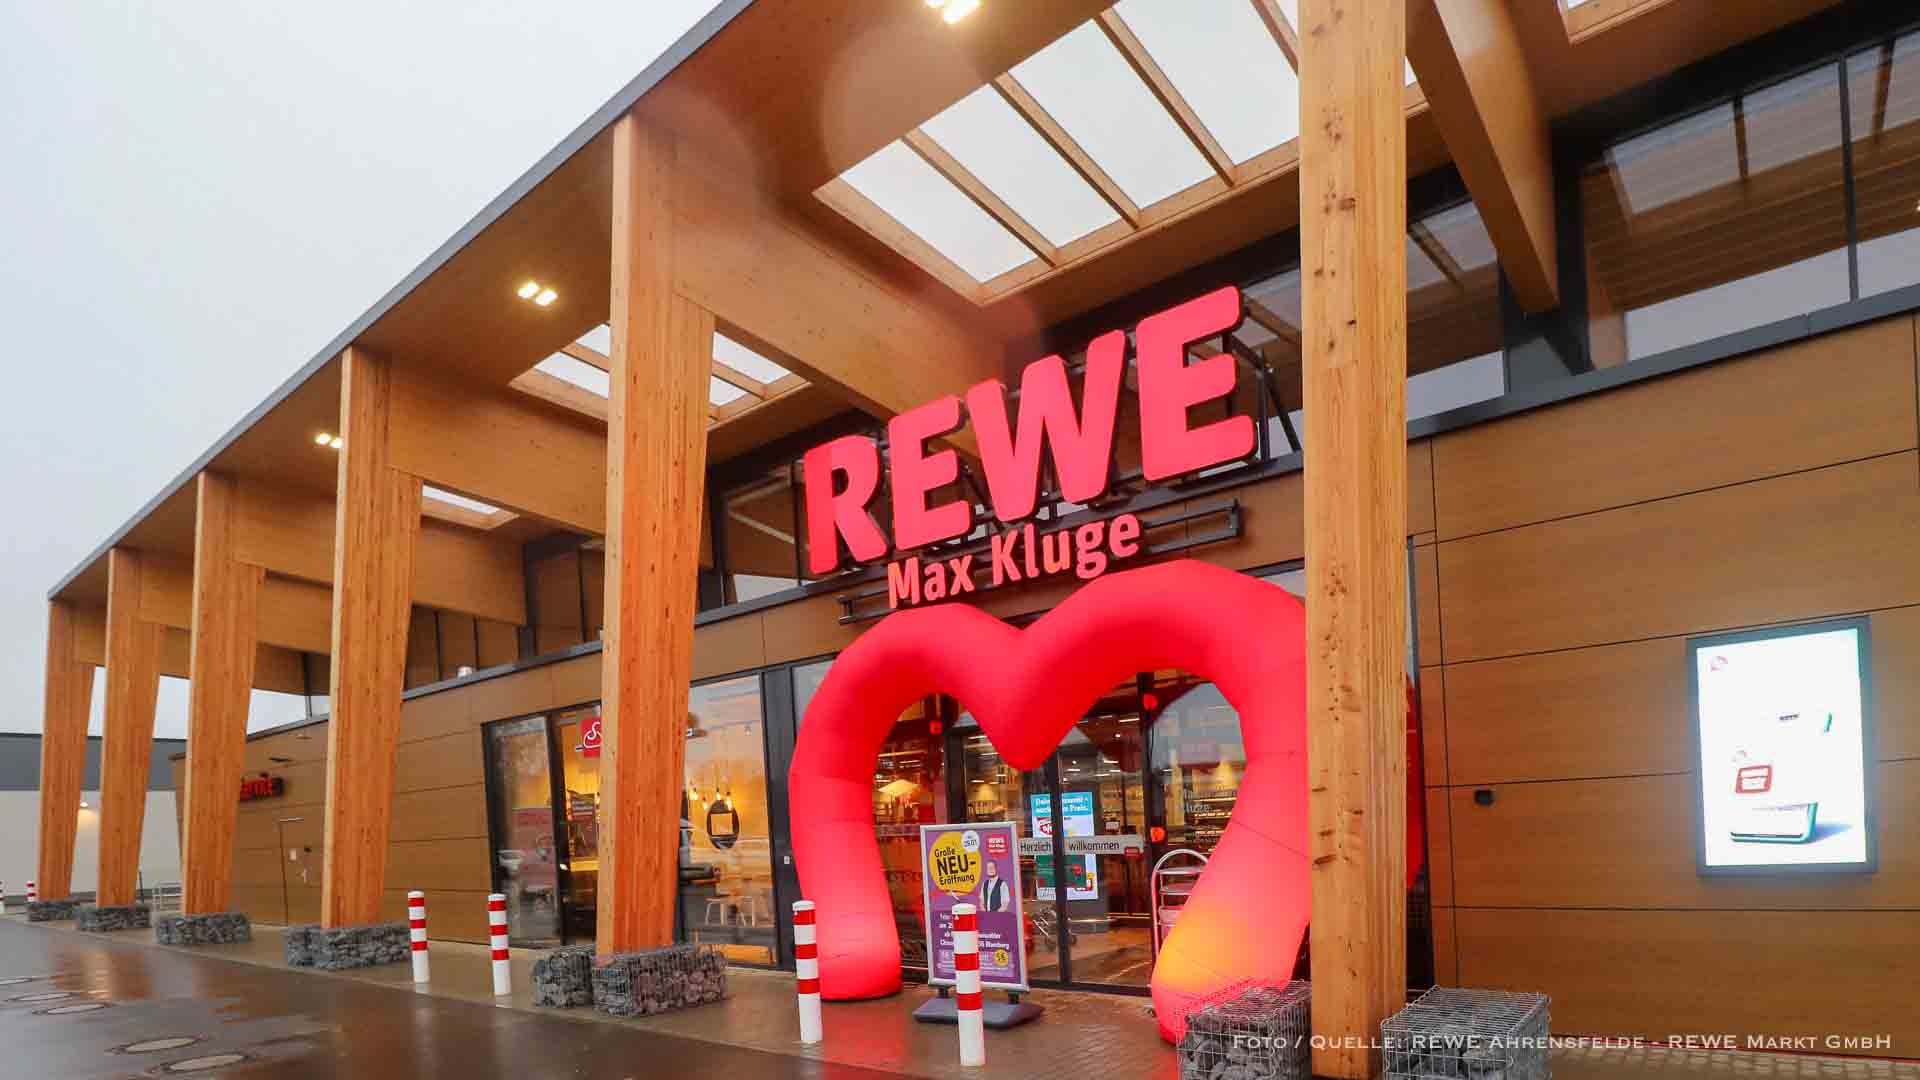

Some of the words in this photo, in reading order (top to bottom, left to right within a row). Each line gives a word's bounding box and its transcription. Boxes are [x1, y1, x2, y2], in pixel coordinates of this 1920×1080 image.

[803, 285, 1256, 574] REWE
[887, 553, 975, 609] Max
[991, 513, 1140, 580] Kluge
[934, 847, 956, 858] Große
[1020, 840, 1052, 853] Herzlich
[1069, 839, 1120, 852] willkommen
[936, 853, 977, 877] NEU-
[939, 873, 975, 886] Eröffnung
